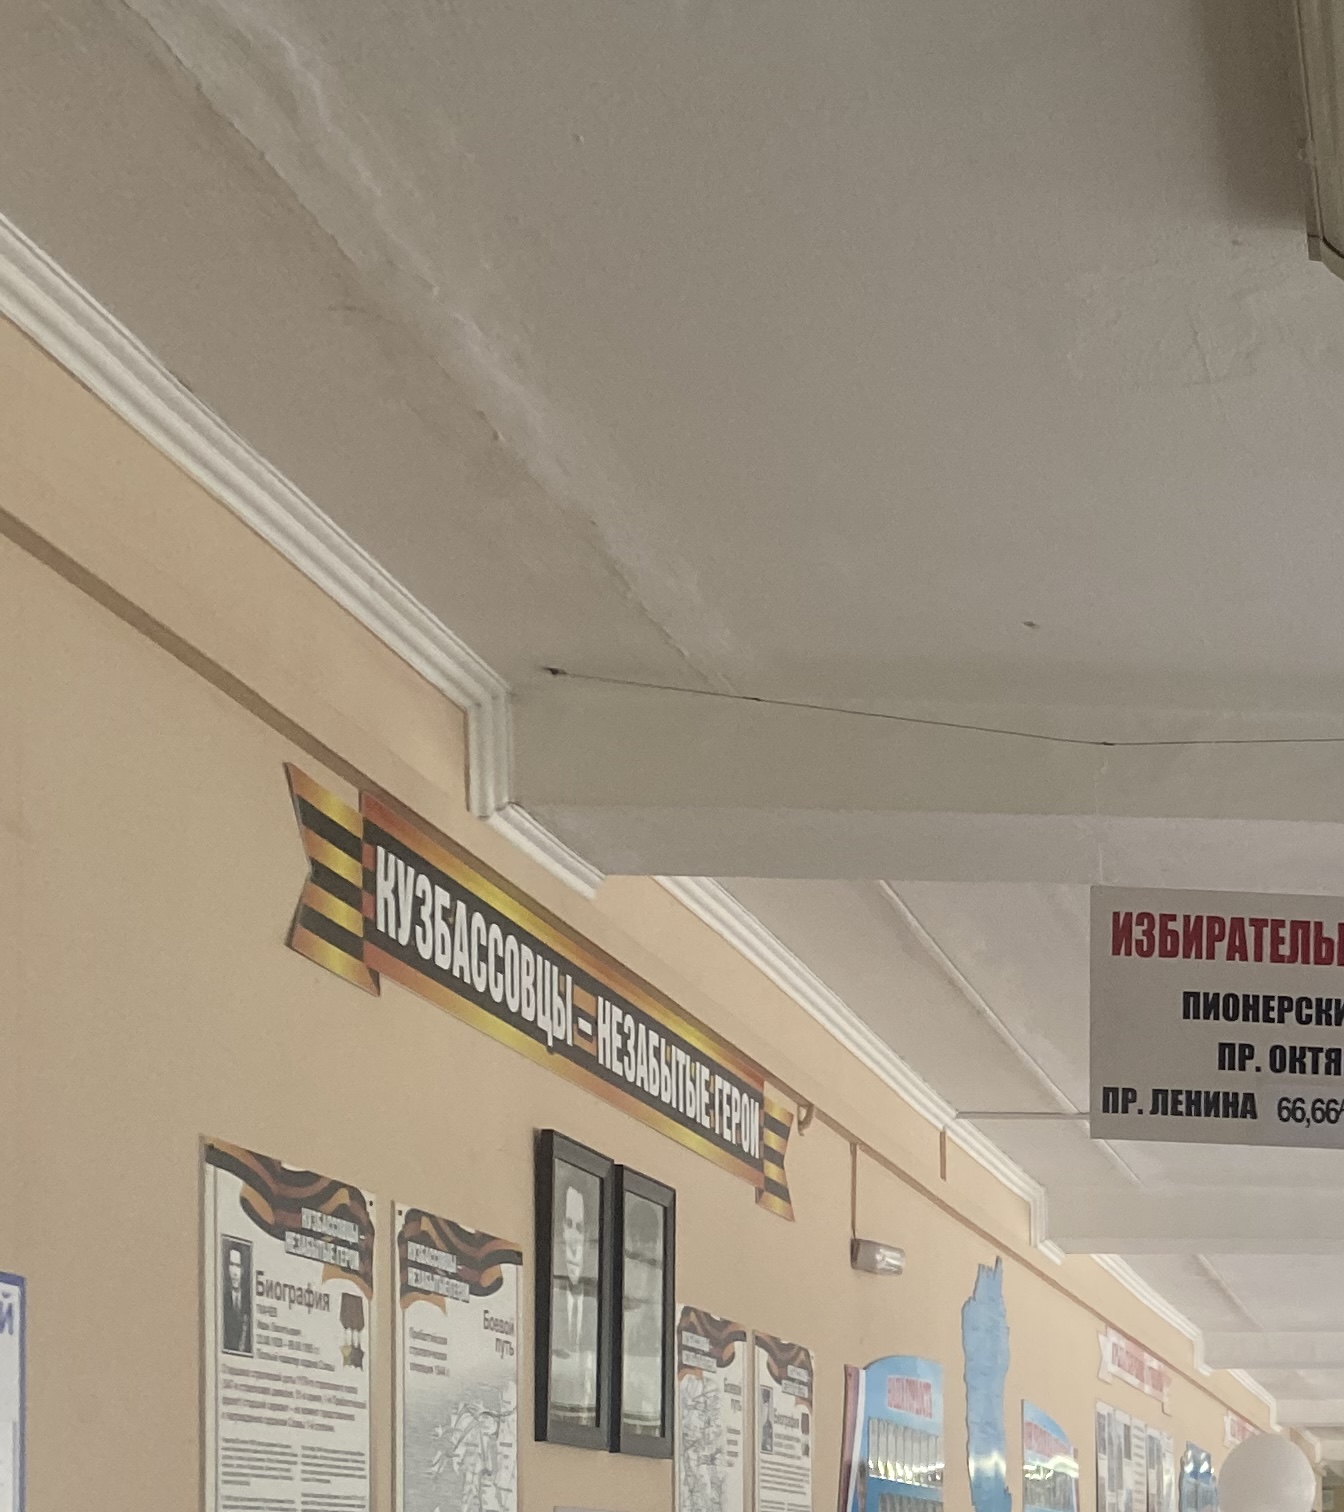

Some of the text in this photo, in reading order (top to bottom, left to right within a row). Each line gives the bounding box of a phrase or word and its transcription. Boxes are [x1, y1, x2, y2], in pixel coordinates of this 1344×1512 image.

[376, 844, 574, 1048] КУЗБАССОВЦЫ
[597, 994, 710, 1129] НЕЗАБЫТЫЕ
[713, 1075, 760, 1159] ГЕРОИ
[1218, 1043, 1262, 1074] ПР.
[1101, 1087, 1145, 1116] ПР.
[1149, 1089, 1258, 1121] ЛЕНИНА
[256, 1270, 330, 1314] Биография
